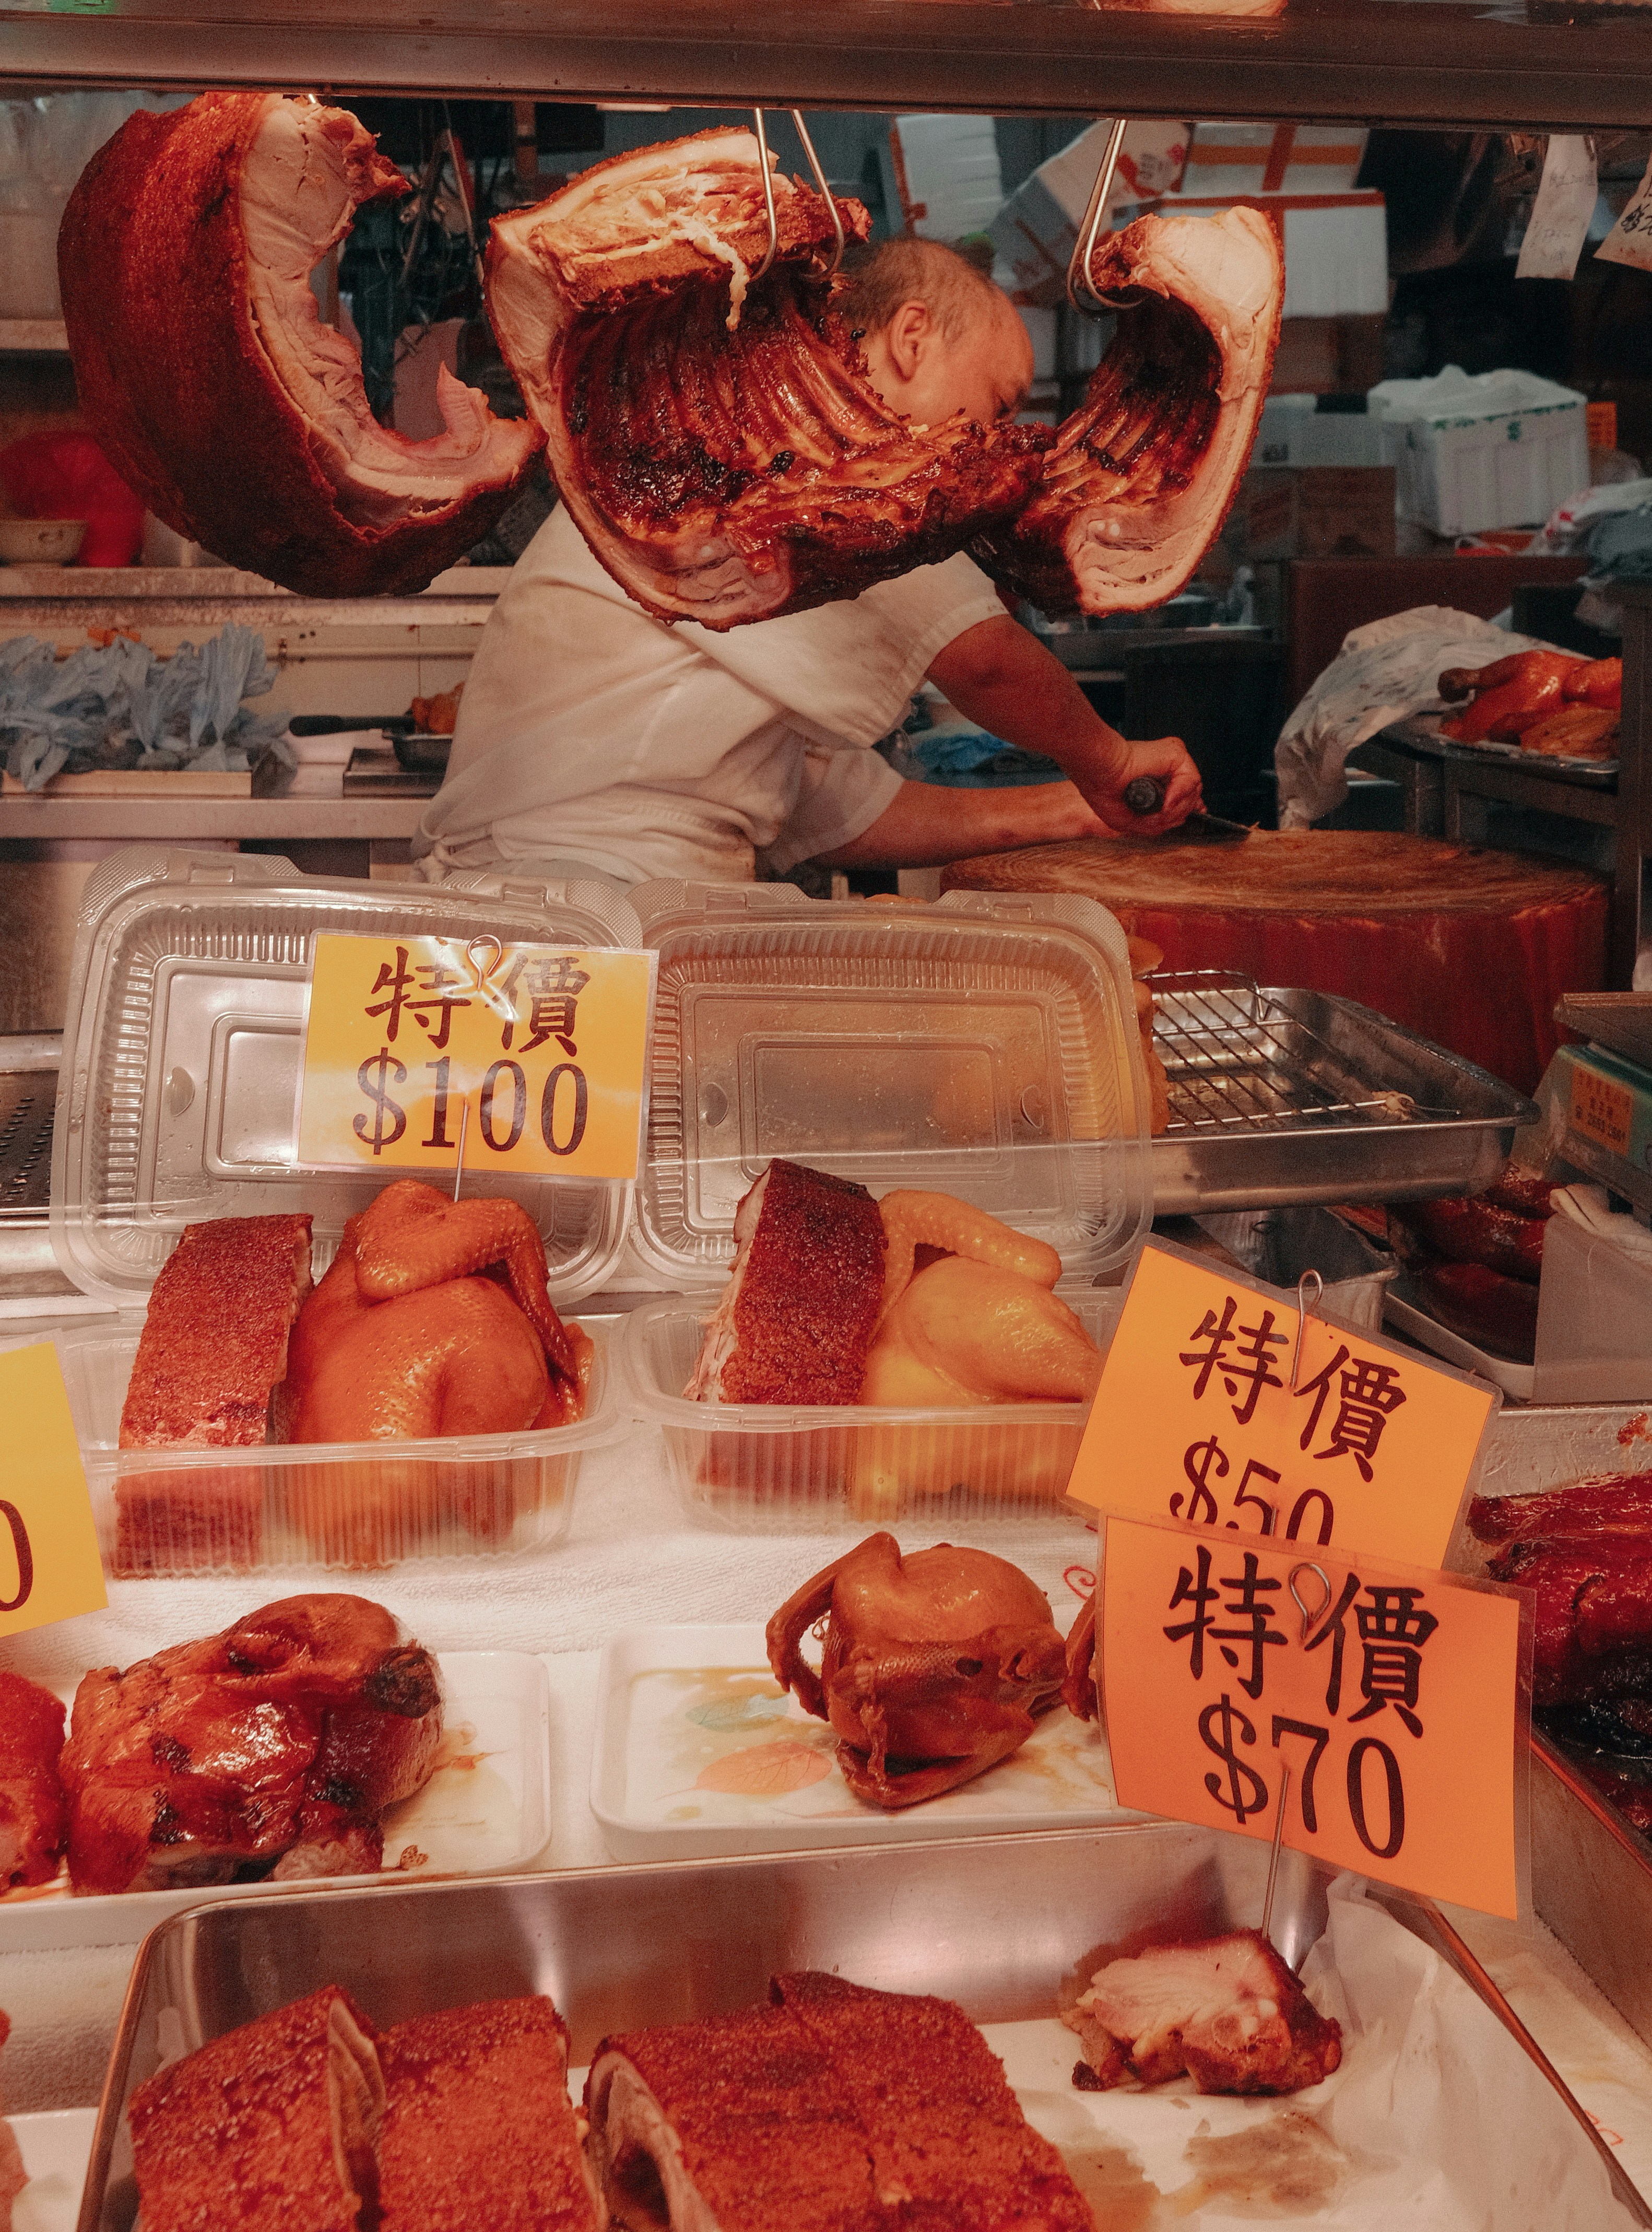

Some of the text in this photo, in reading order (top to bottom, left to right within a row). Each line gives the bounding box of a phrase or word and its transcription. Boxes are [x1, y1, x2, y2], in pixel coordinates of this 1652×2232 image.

[365, 946, 591, 1057] 特價
[352, 1047, 588, 1156] $100
[1178, 1296, 1407, 1483] 特價
[1162, 1544, 1439, 1738] 特價
[1198, 1694, 1405, 1859] $70
